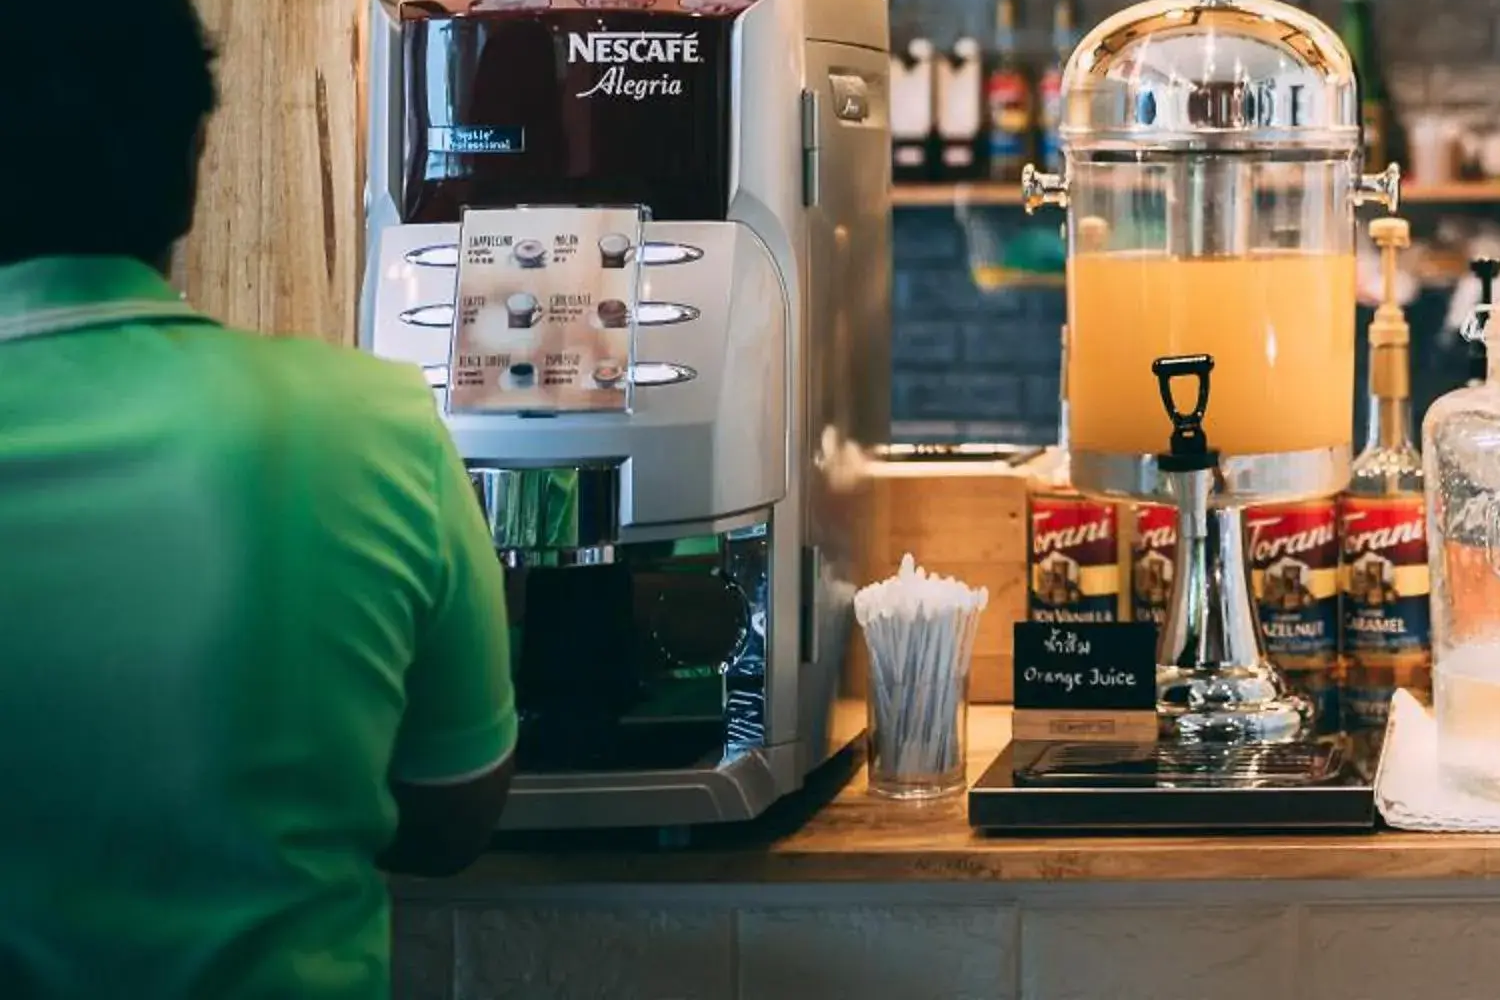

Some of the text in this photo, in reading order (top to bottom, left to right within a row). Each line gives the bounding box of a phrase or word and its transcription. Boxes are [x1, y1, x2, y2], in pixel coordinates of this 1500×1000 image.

[567, 31, 699, 63] NESCAFÉ
[575, 65, 683, 101] Alegria
[1247, 509, 1335, 561] Torani
[1262, 620, 1325, 637] AZELNUT
[1023, 666, 1137, 692] Orange Juice
